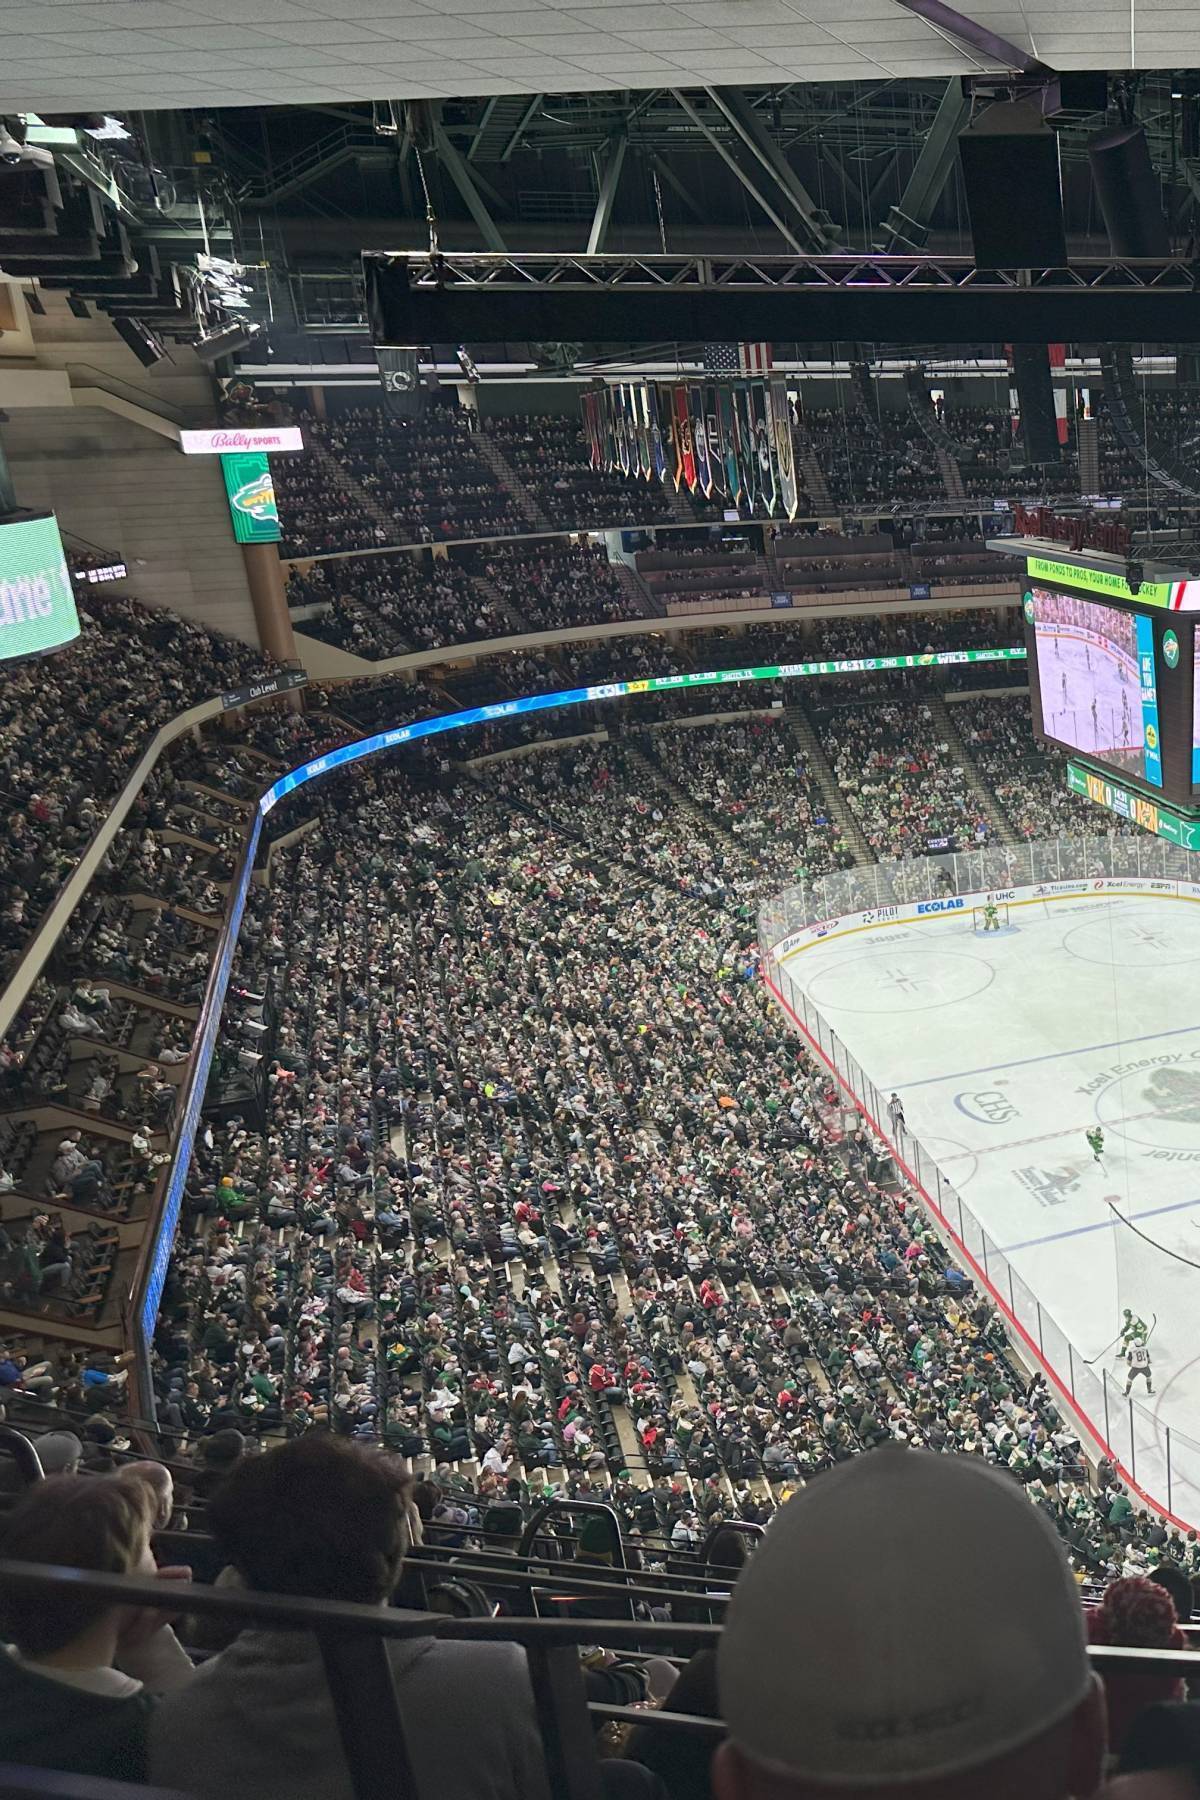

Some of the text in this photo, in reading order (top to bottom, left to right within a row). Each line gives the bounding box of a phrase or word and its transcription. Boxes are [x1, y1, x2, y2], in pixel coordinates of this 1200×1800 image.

[211, 433, 281, 449] Bally SPORTS
[1036, 559, 1049, 572] FROM
[1050, 562, 1065, 576] PONDS
[1066, 566, 1073, 577] TO
[1074, 568, 1088, 583] PROS,
[1089, 571, 1103, 585] YOUR
[1105, 574, 1121, 588] HOME
[249, 681, 278, 698] Club Level
[995, 891, 1016, 901] UHC
[917, 898, 964, 914] ECOLAB
[1074, 1072, 1113, 1096] Xcel
[1110, 1053, 1182, 1076] Energy
[974, 1091, 1022, 1121] CHS
[1170, 1548, 1178, 1558] 12
